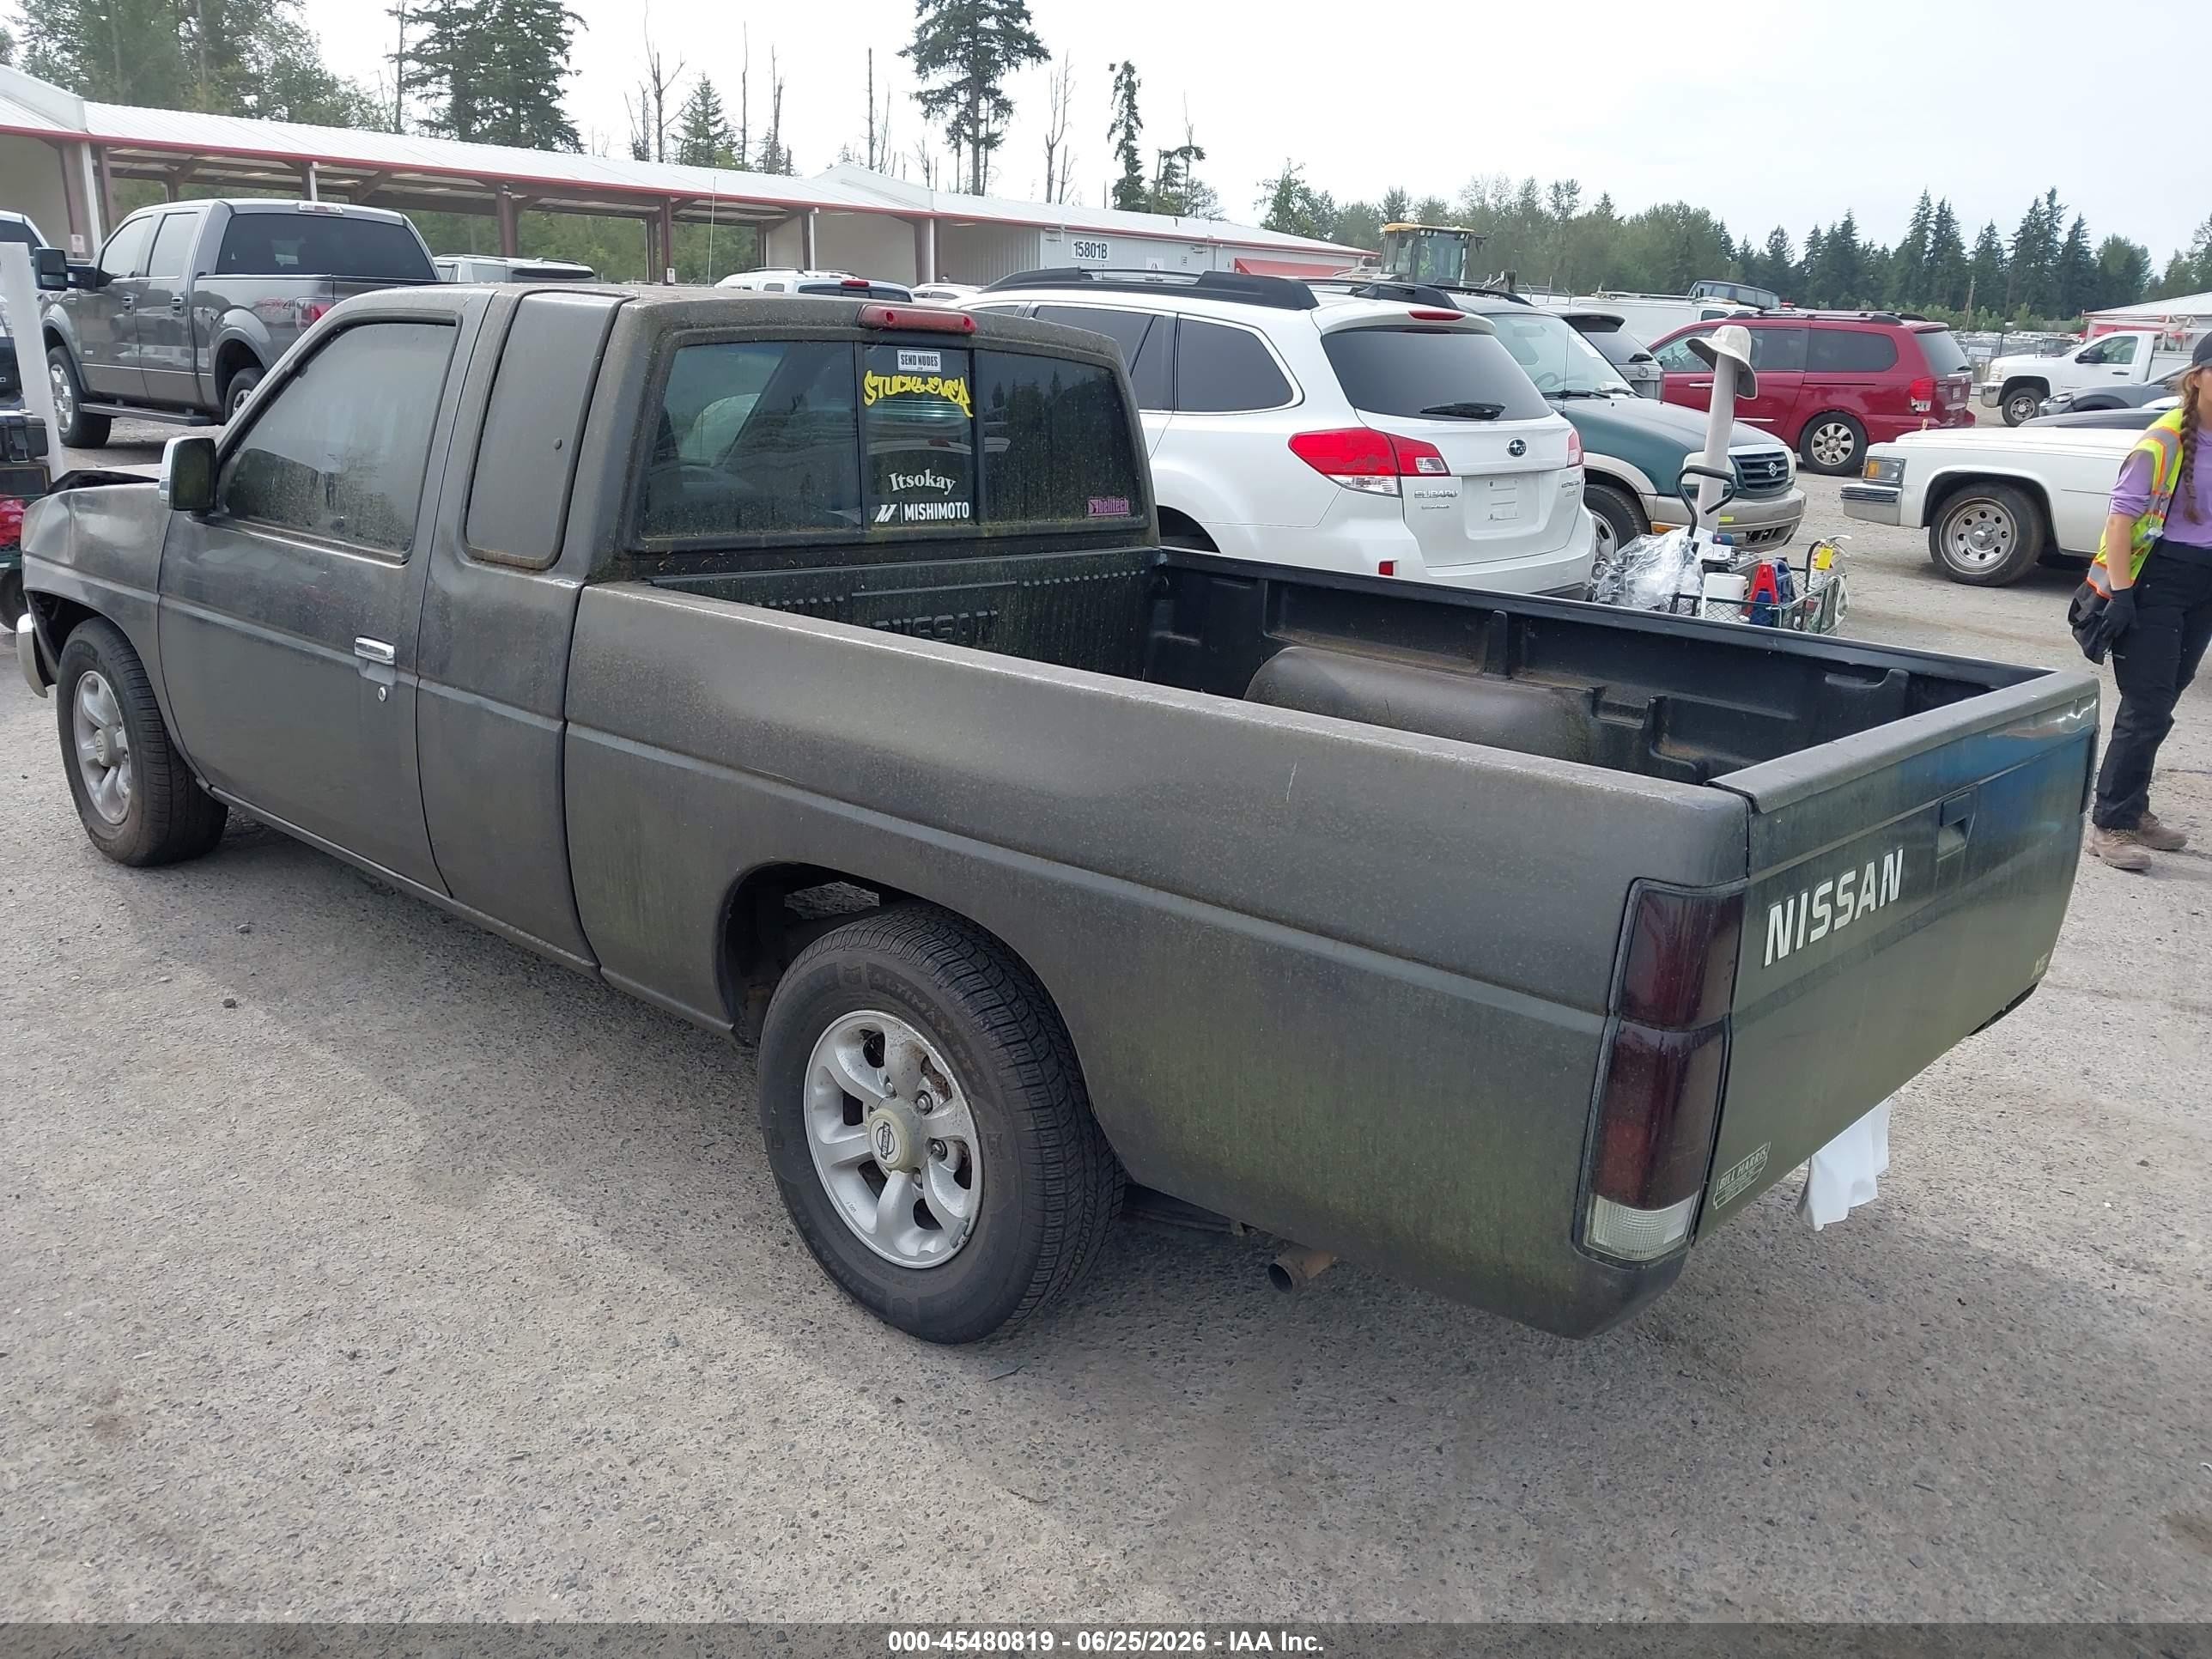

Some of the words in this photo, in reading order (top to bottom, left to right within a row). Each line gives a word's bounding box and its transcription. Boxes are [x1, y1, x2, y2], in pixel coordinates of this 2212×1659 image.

[1073, 241, 1108, 259] 15801B
[900, 354, 917, 366] SEND
[918, 355, 939, 368] NUDES
[888, 468, 957, 495] Itsokay
[1413, 489, 1459, 499] SUBARU
[903, 501, 970, 521] MISHIMOTO
[1762, 846, 1904, 969] NISSAN
[1736, 1146, 1768, 1178] HARRIS
